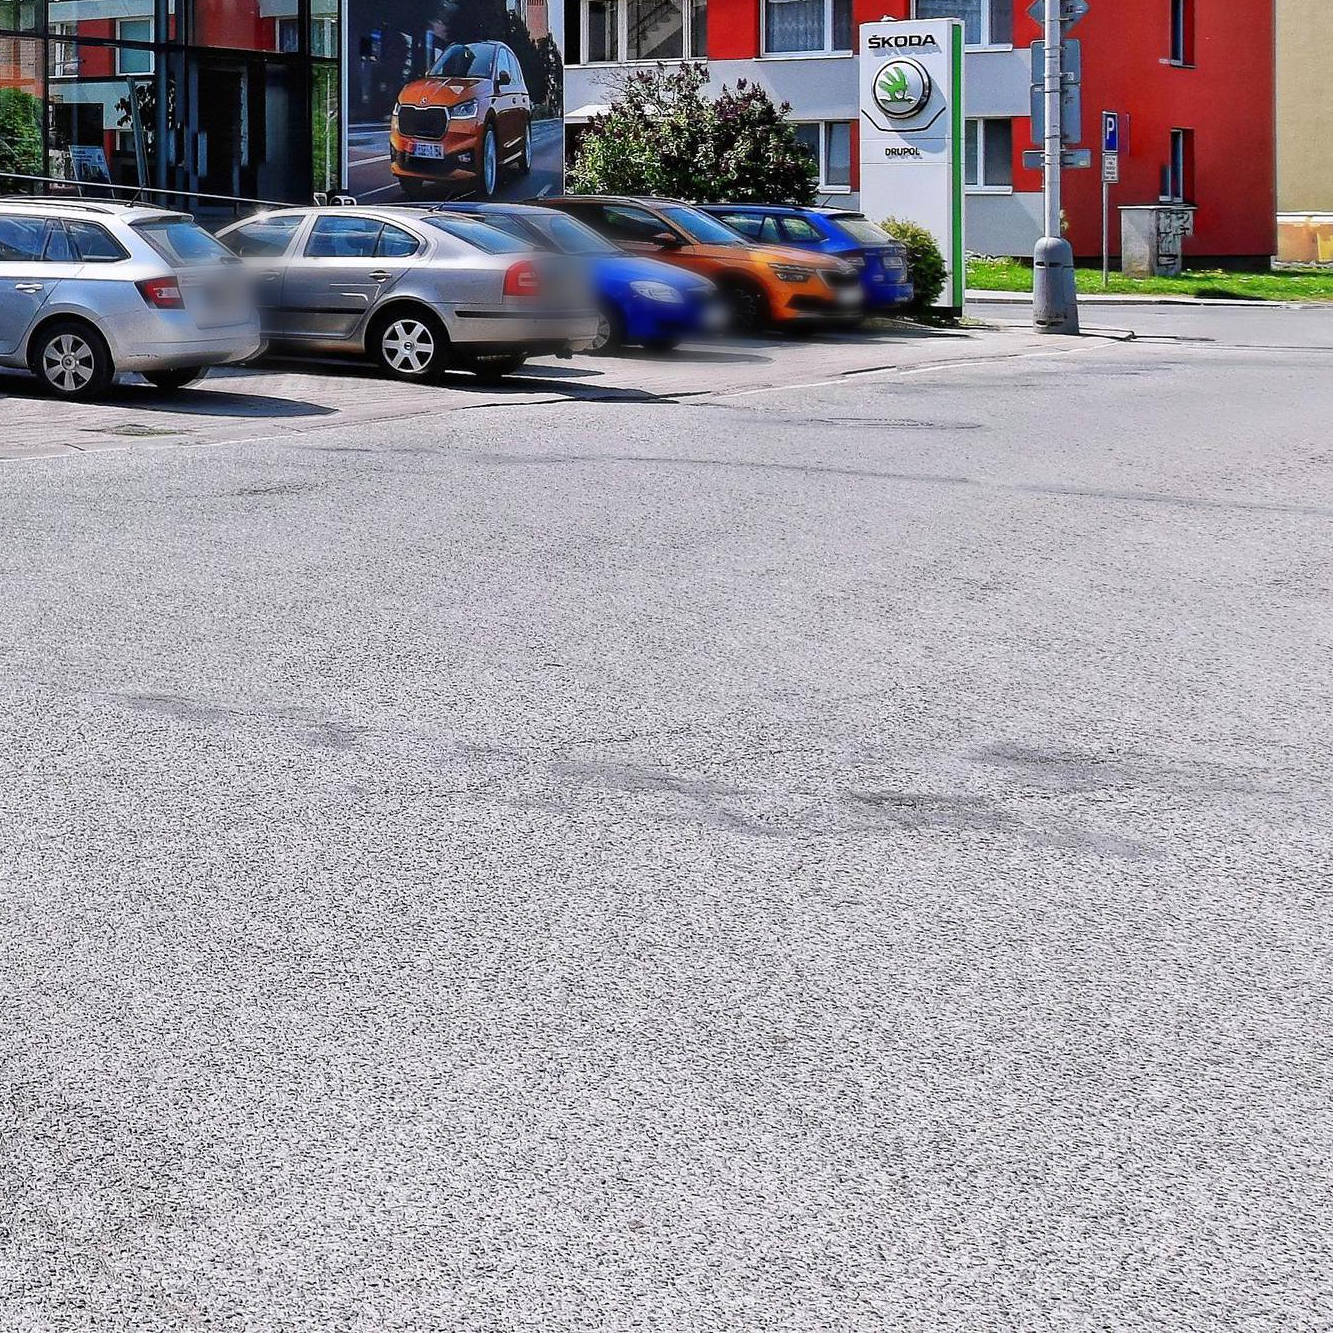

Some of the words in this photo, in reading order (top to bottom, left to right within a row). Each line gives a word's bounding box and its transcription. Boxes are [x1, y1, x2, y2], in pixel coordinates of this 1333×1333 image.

[867, 34, 937, 49] ŠKODA
[1106, 117, 1115, 140] P
[884, 147, 921, 157] DRUPOL
